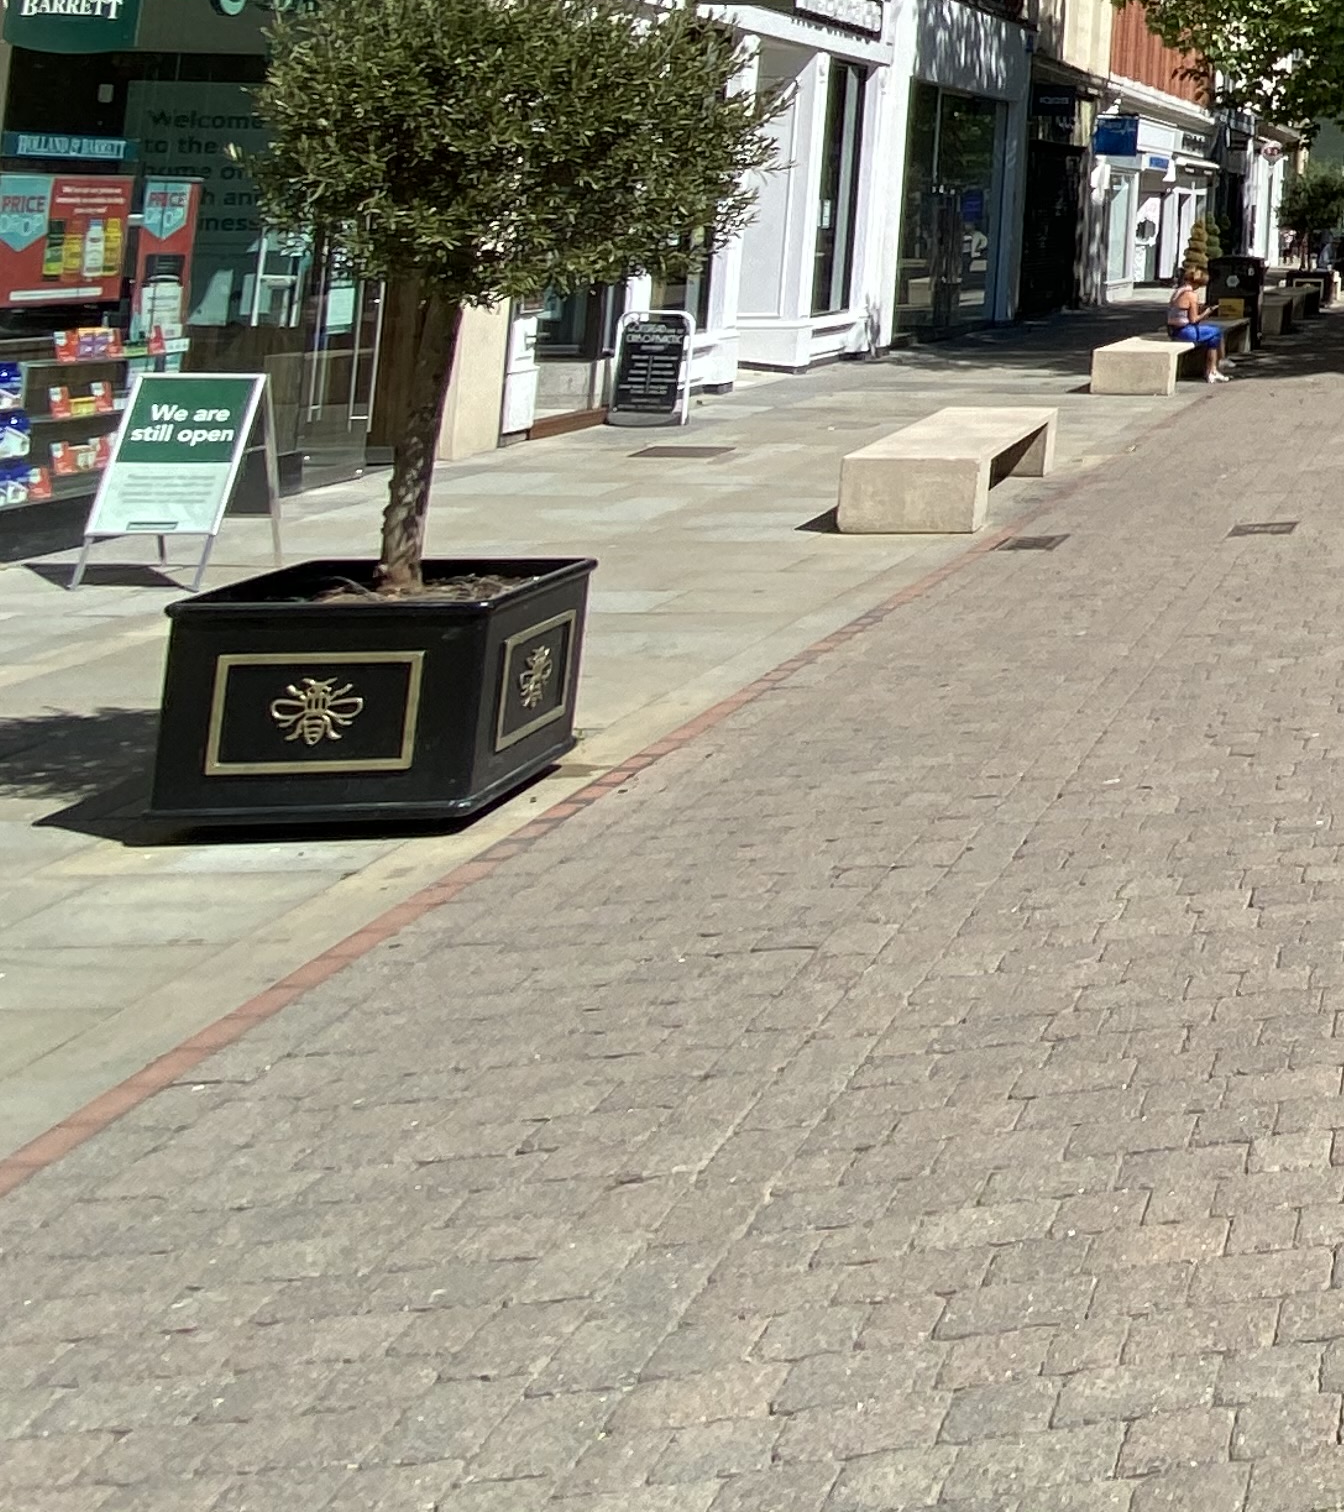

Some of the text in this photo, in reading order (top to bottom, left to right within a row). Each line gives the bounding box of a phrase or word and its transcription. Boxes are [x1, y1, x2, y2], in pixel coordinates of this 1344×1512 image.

[149, 110, 264, 129] Welcome
[178, 136, 218, 154] the
[2, 195, 46, 213] PRICE
[148, 192, 187, 207] PRICE
[151, 403, 231, 423] We are
[130, 424, 235, 447] still open
